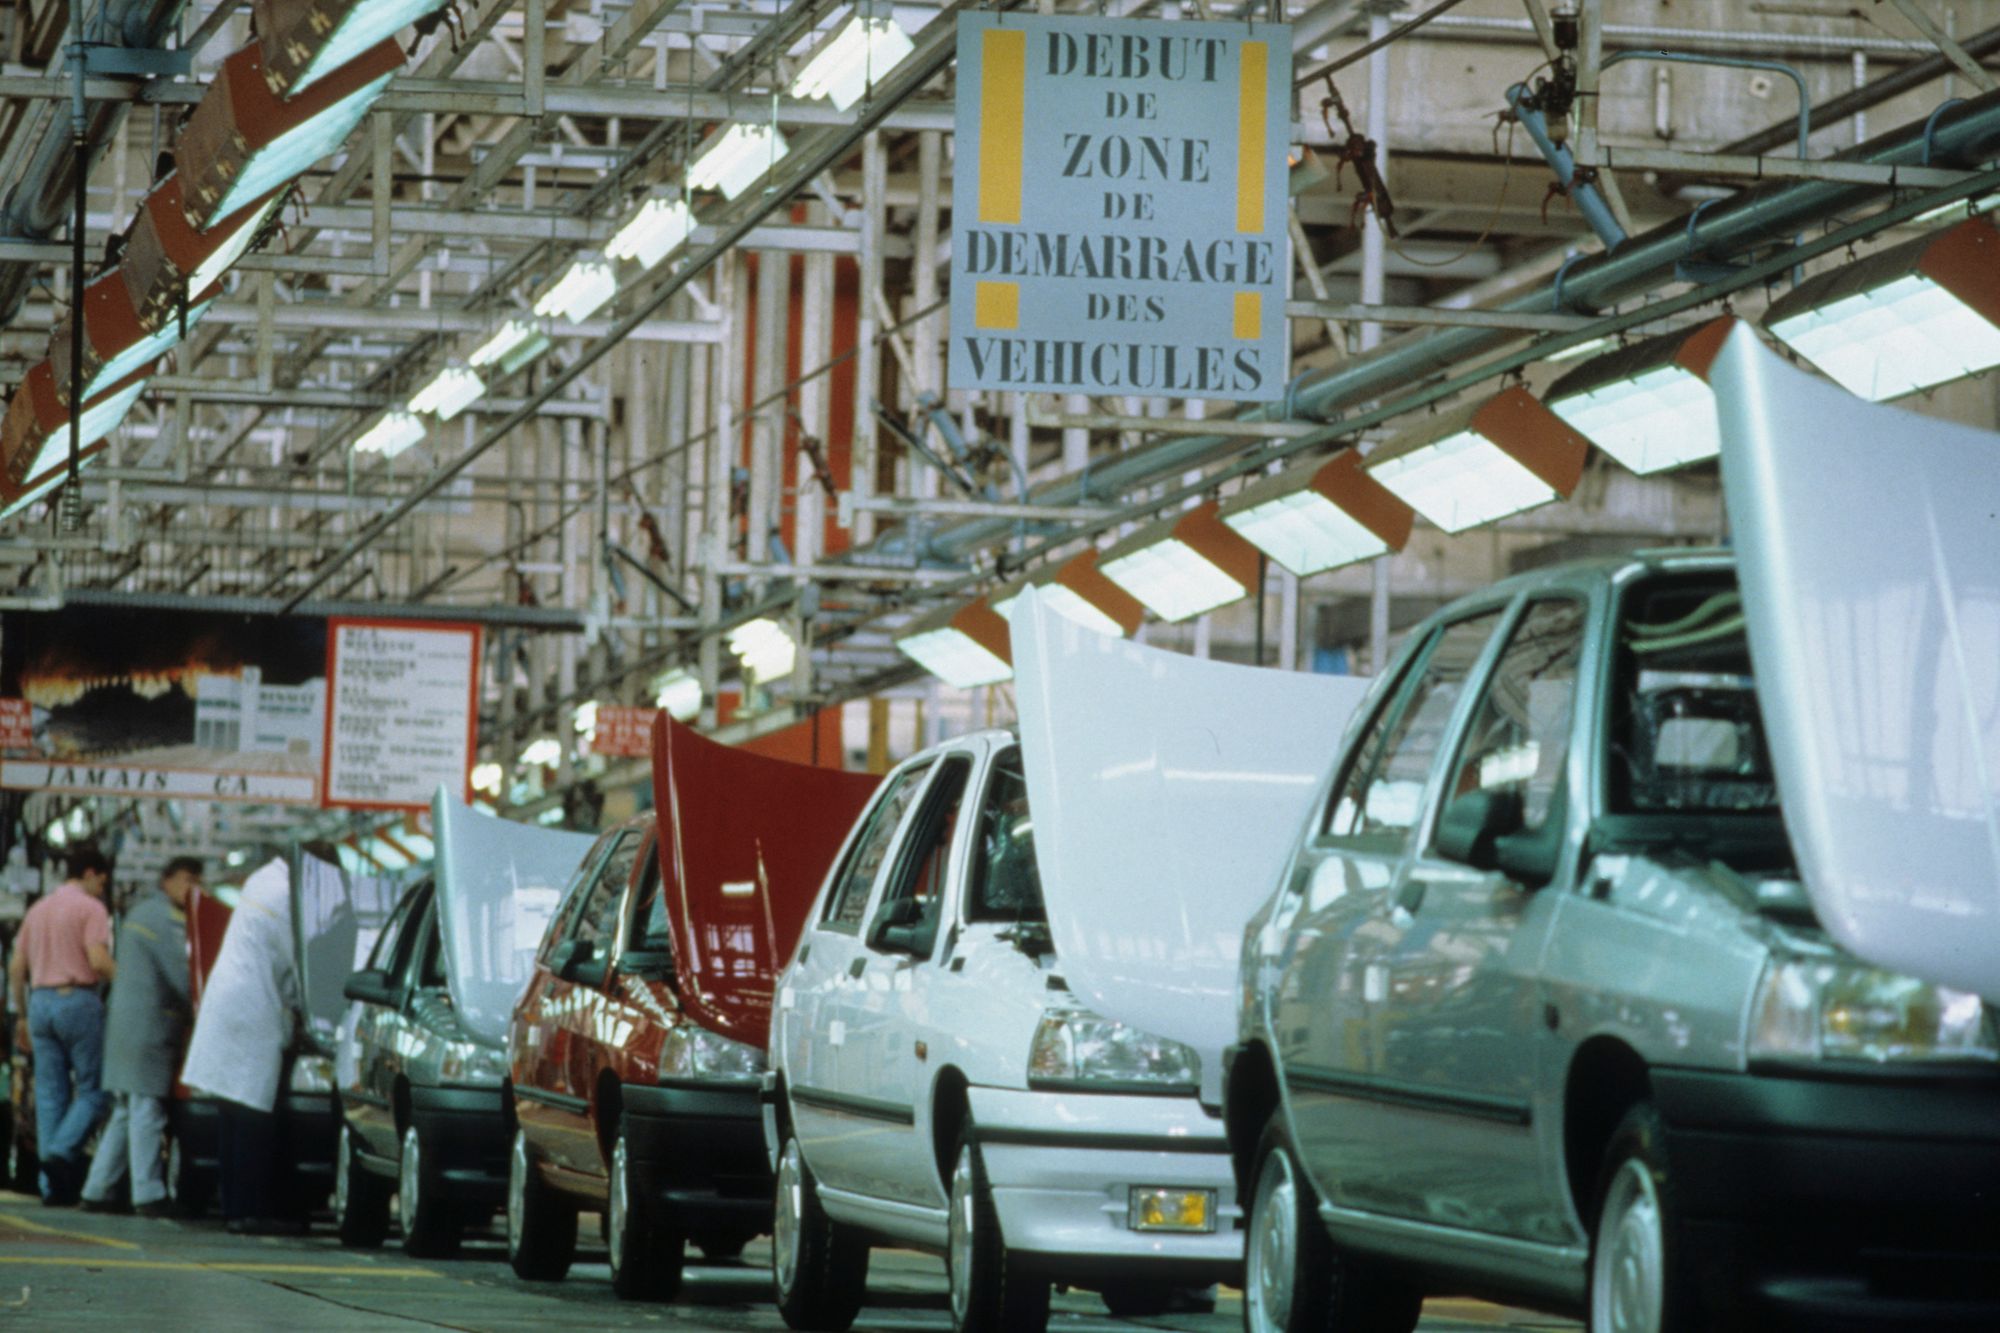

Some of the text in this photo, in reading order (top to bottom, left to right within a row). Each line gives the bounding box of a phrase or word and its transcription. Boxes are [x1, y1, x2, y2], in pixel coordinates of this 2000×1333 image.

[1046, 31, 1226, 82] DEBUT
[1105, 91, 1157, 120] DE
[1062, 133, 1210, 183] ZONE
[1103, 192, 1154, 221] DE
[964, 230, 1273, 285] DEMARRAGE
[1087, 293, 1165, 323] DES
[963, 336, 1263, 392] VEHICULES
[45, 766, 167, 789] JAMAIS
